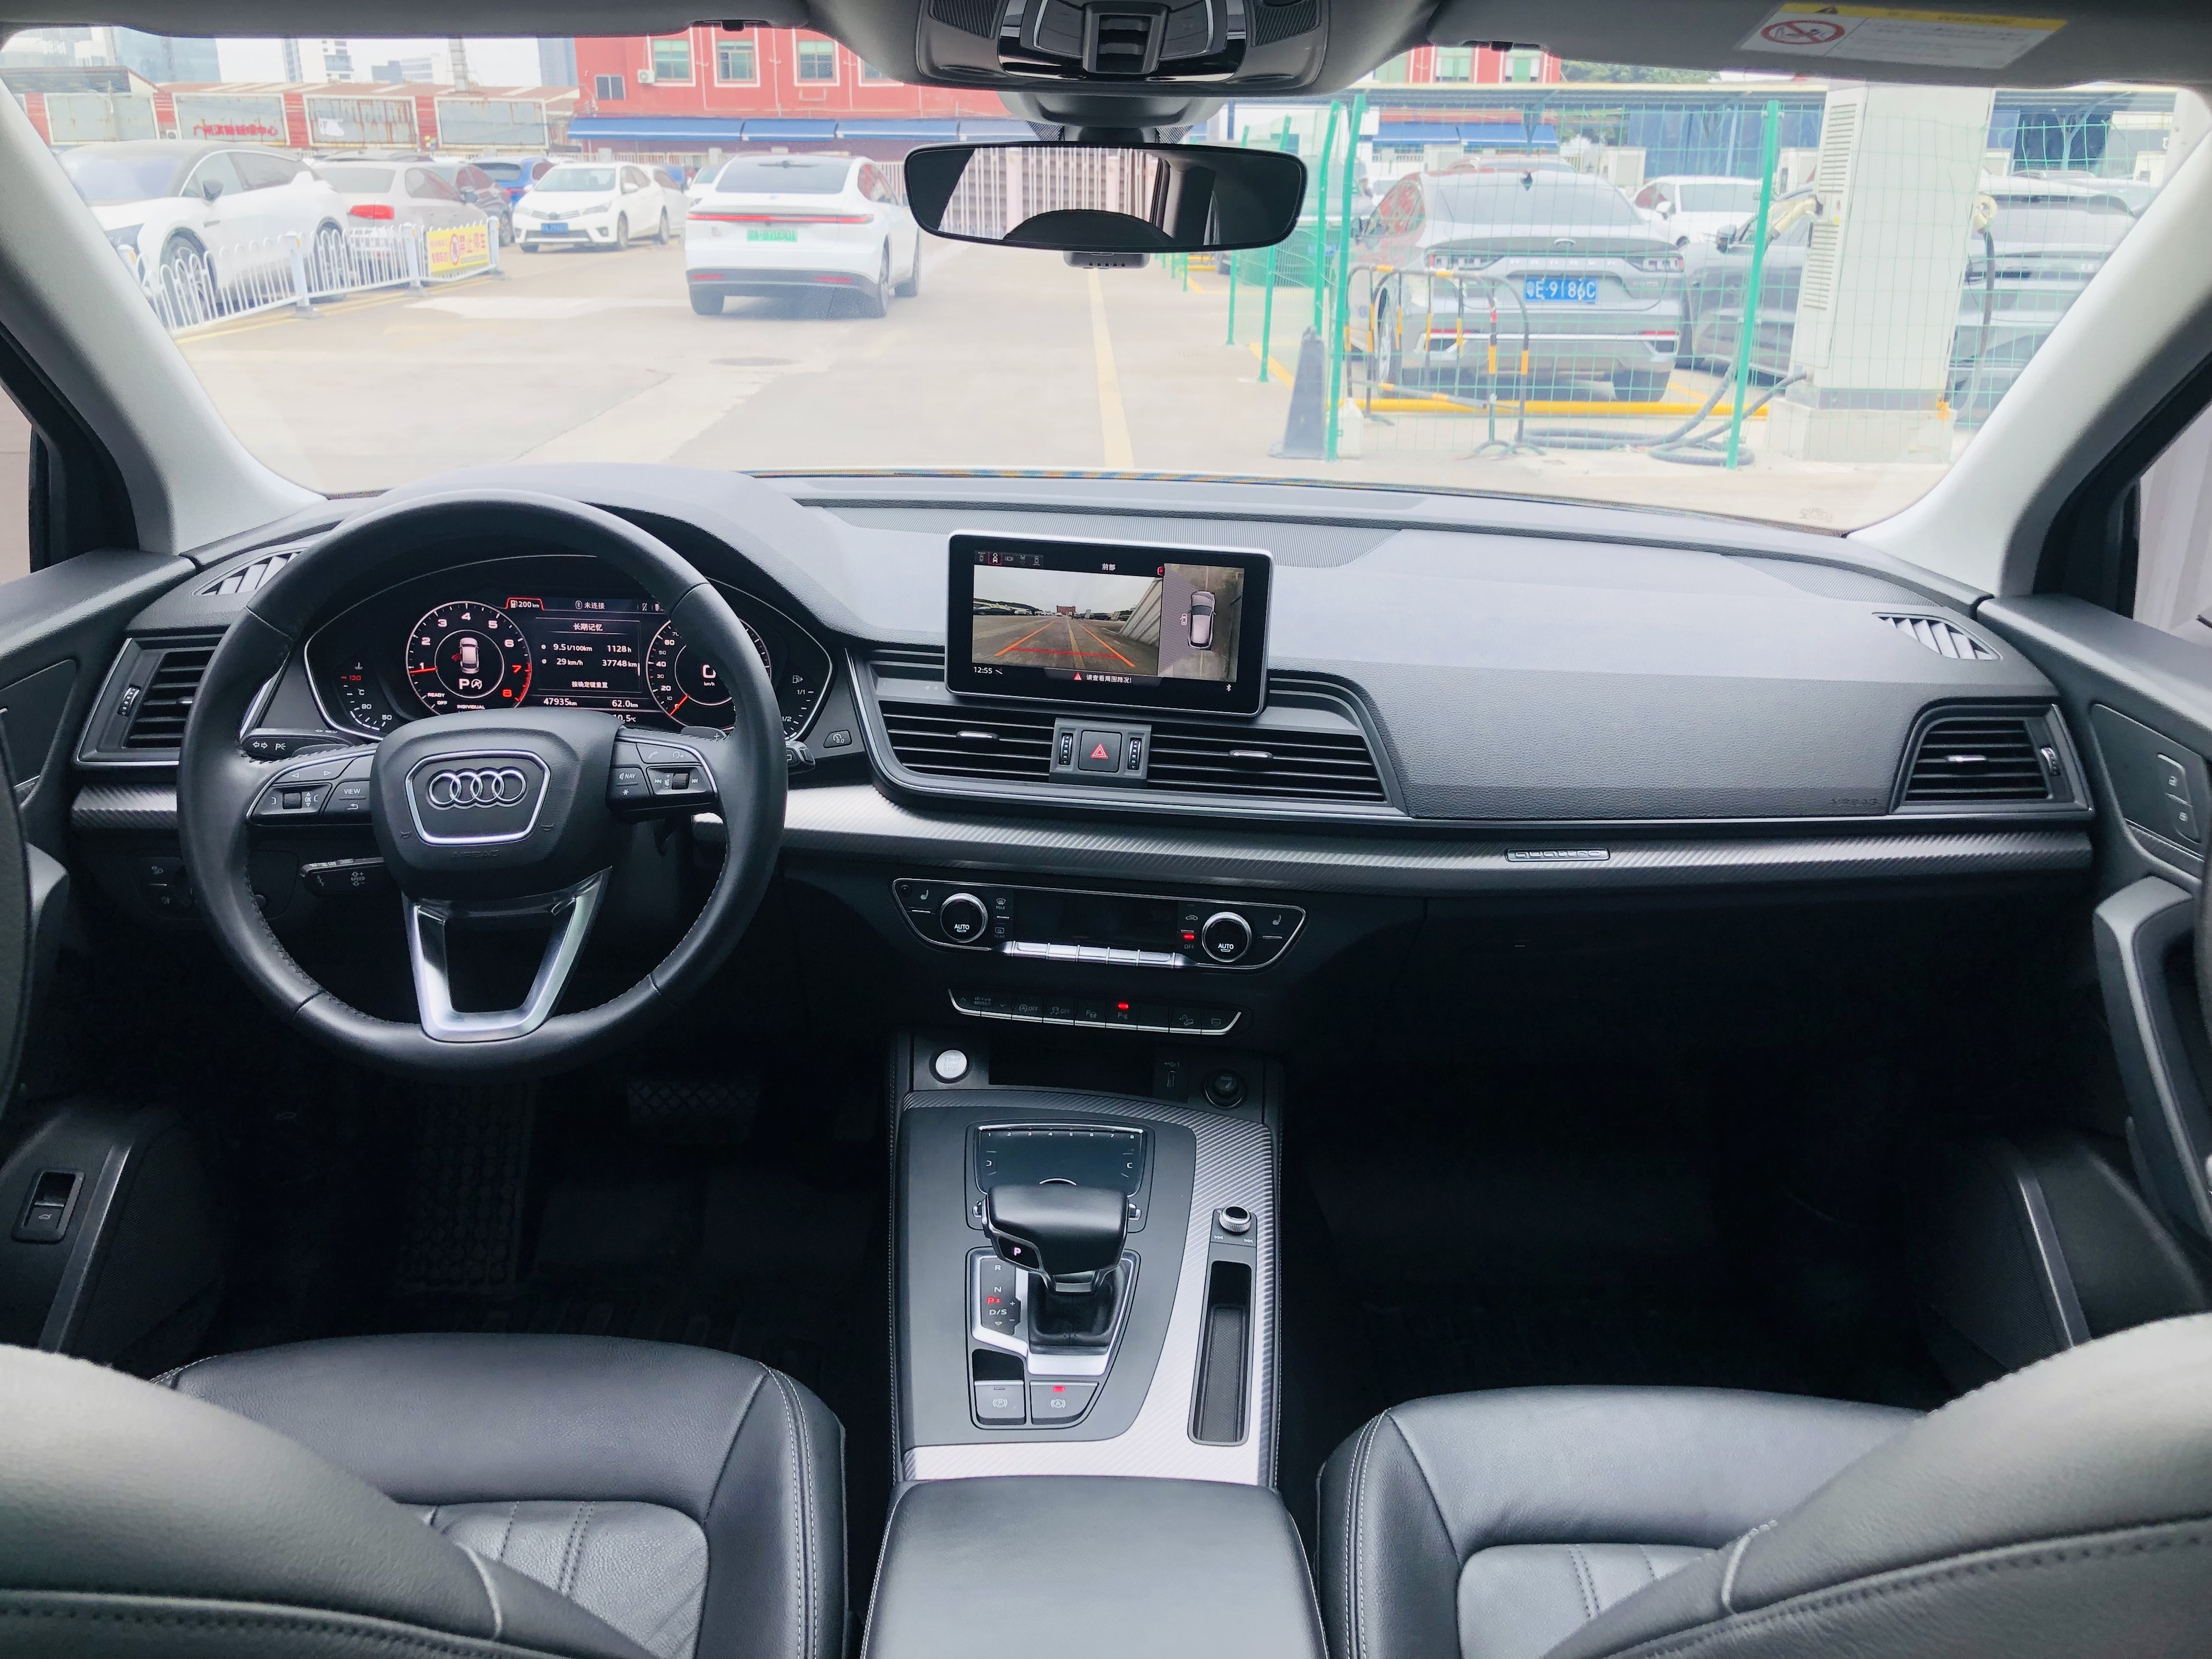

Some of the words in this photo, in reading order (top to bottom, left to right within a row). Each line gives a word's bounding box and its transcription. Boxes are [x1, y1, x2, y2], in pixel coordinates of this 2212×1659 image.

[1102, 562, 1116, 571] 前部
[461, 612, 471, 620] 4
[438, 619, 447, 627] 3
[488, 620, 498, 629] 5
[573, 623, 603, 631] 长期记忆
[421, 637, 431, 646] 2
[505, 639, 514, 647] 6
[607, 645, 627, 653] 1128
[511, 665, 521, 673] 7
[702, 664, 716, 679] 0
[459, 678, 470, 690] P
[503, 689, 512, 697] 8
[1515, 850, 1601, 859] quattro
[1014, 1247, 1022, 1256] P
